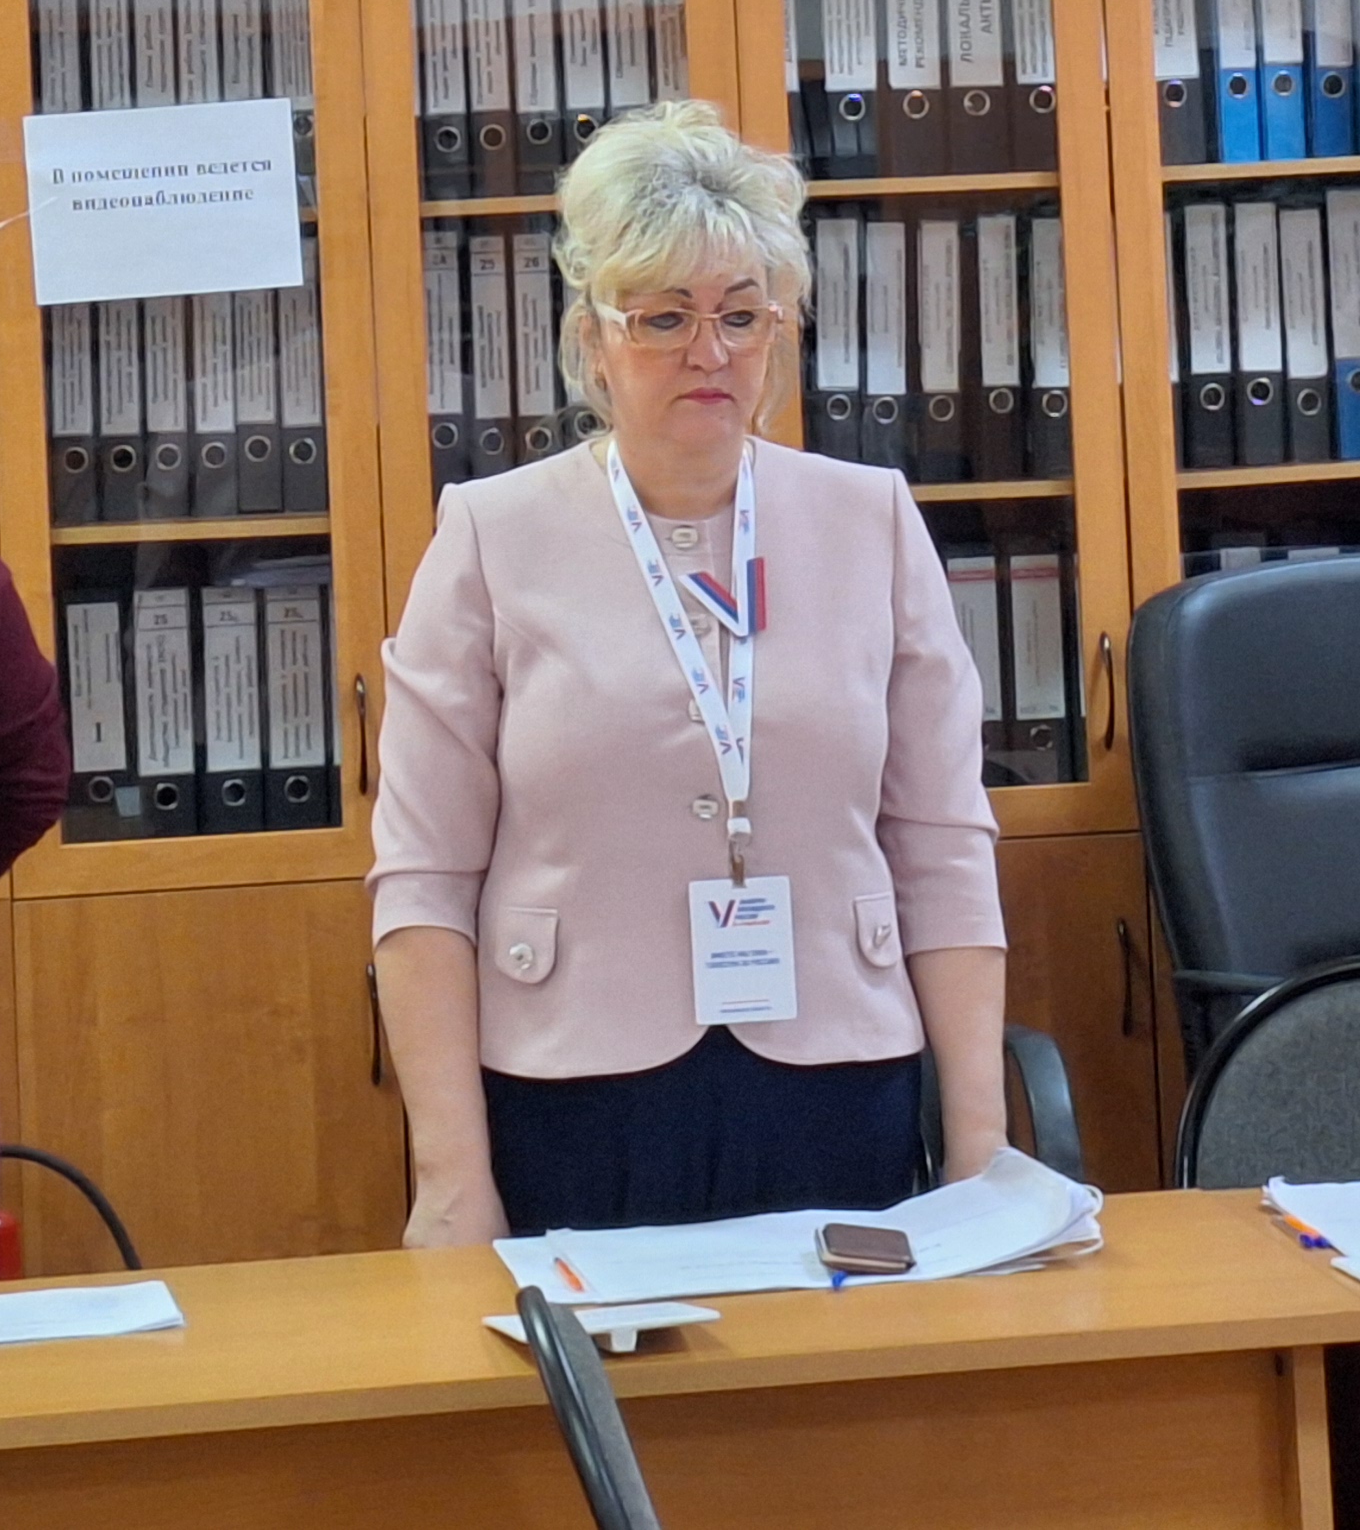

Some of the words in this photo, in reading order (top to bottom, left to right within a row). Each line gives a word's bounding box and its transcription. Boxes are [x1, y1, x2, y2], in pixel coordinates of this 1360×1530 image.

[71, 165, 189, 183] помещении
[196, 159, 272, 176] ведется
[72, 187, 255, 212] видеонаблюдение
